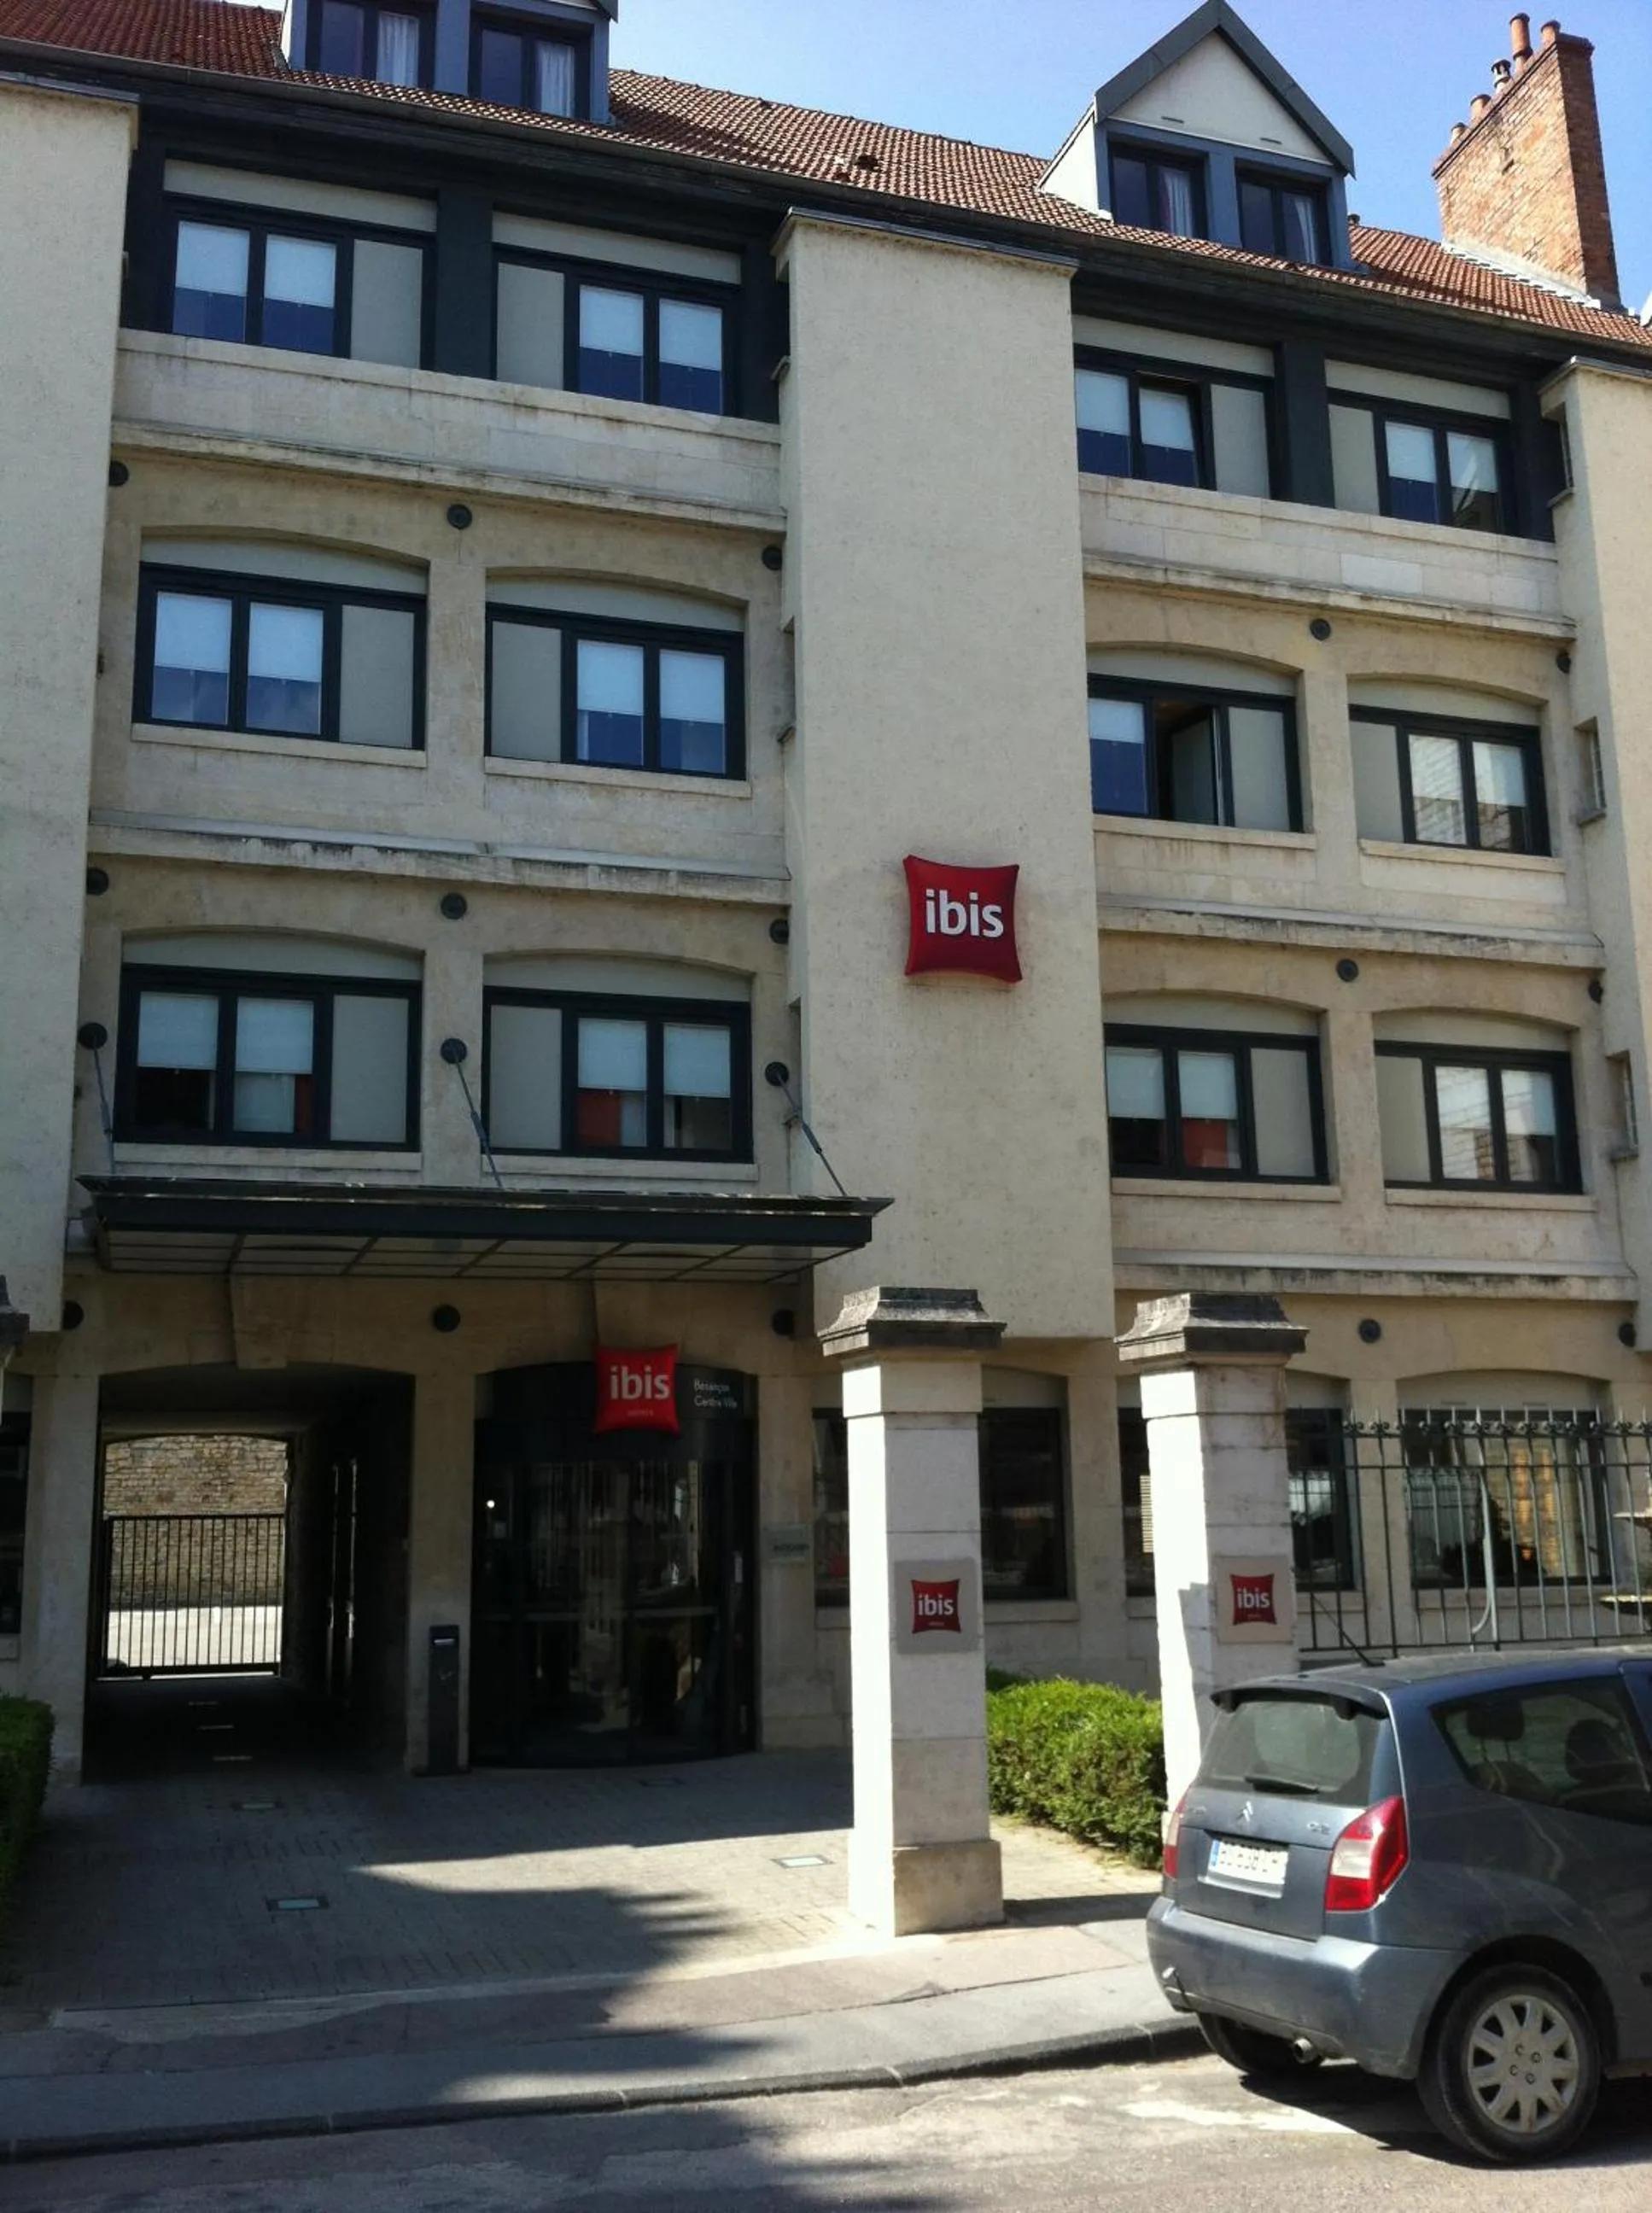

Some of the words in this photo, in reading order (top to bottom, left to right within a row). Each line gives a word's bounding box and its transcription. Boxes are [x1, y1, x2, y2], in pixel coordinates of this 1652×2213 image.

[925, 889, 1002, 937] ibis
[610, 1366, 670, 1400] ibis
[918, 1592, 954, 1615] ibis
[1236, 1586, 1270, 1609] ibis
